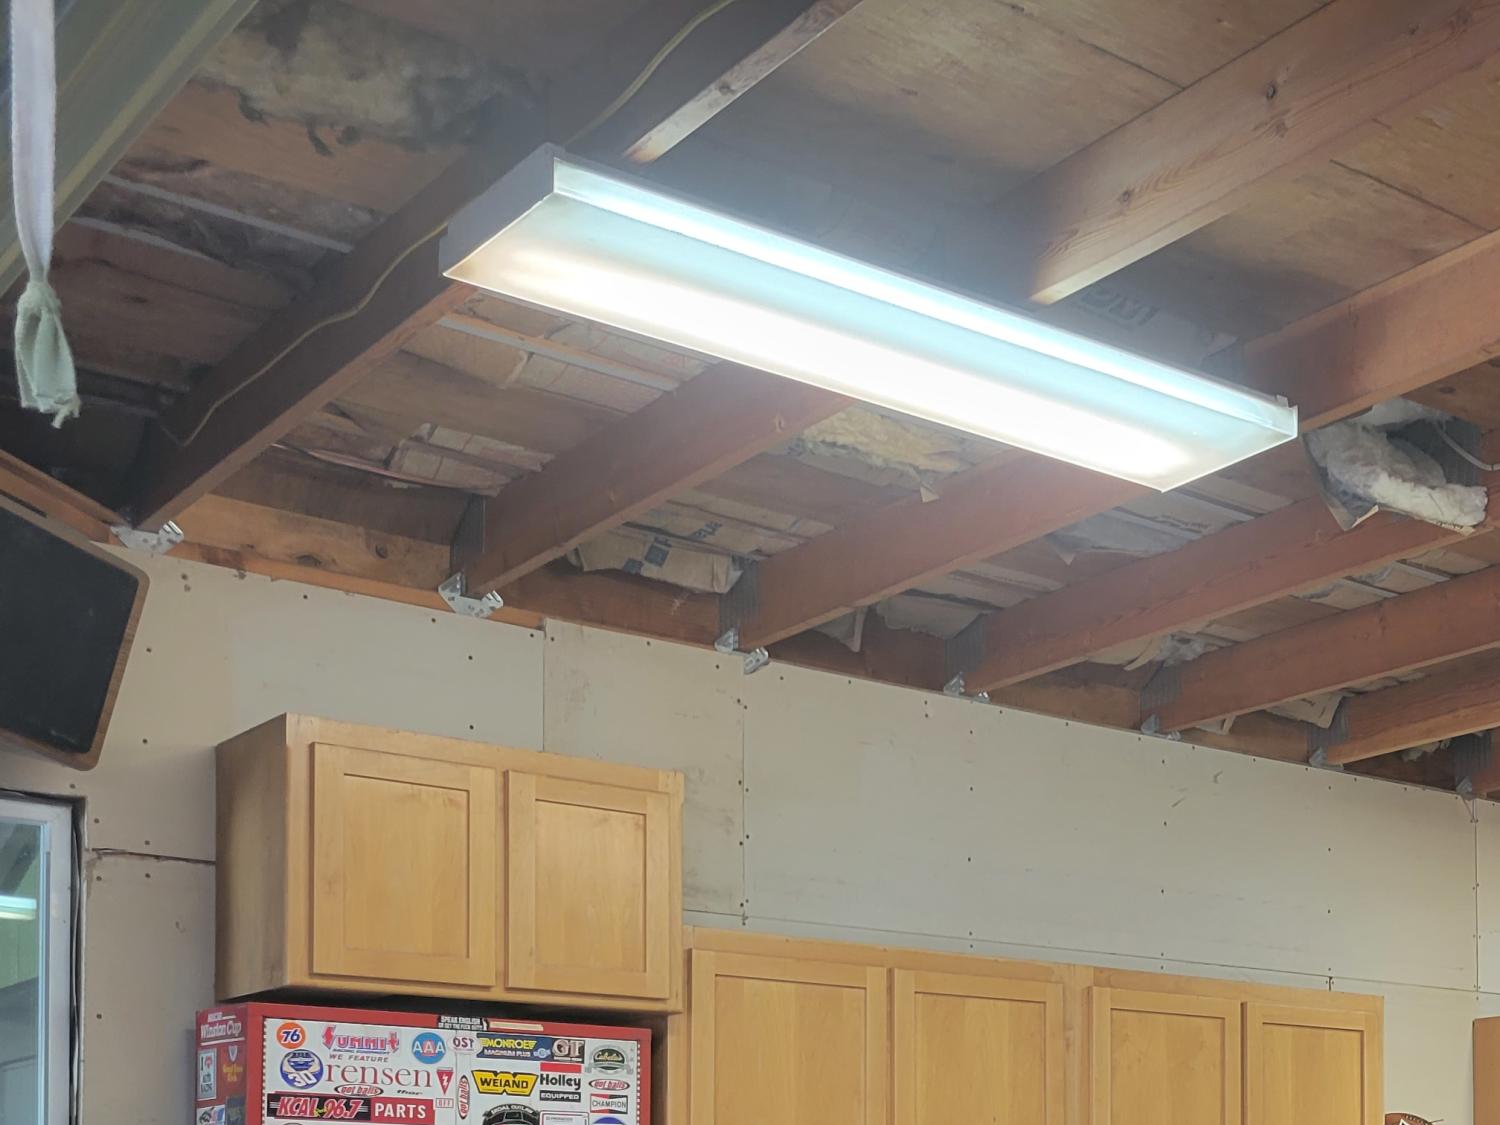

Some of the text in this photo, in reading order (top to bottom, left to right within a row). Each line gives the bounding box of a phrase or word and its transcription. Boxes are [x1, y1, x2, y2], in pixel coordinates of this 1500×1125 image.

[227, 1021, 242, 1036] Cup
[281, 1029, 302, 1044] 76
[484, 1038, 535, 1049] MONROE
[413, 1041, 446, 1055] AAA
[480, 1078, 529, 1089] WEIAND
[540, 1074, 581, 1090] Holley
[375, 1103, 426, 1118] PARTS
[591, 1099, 627, 1109] CHAMPION
